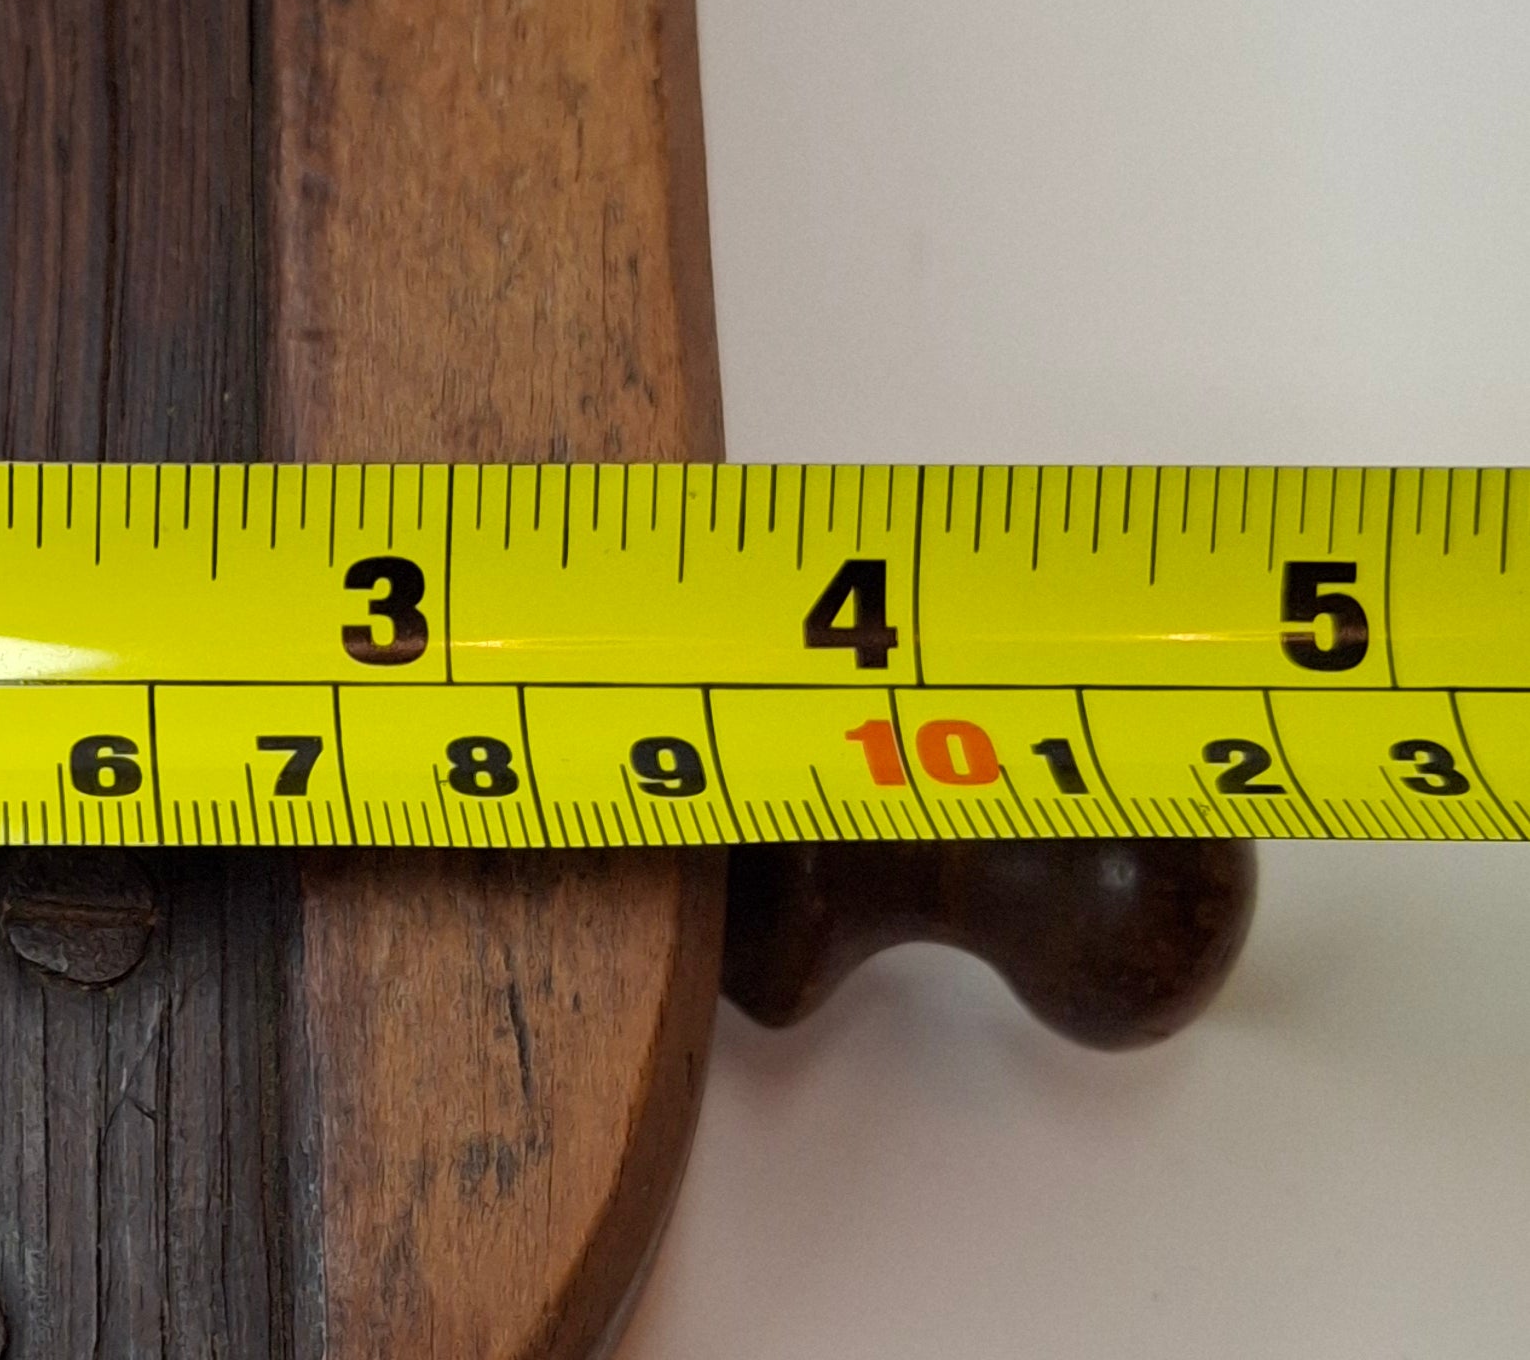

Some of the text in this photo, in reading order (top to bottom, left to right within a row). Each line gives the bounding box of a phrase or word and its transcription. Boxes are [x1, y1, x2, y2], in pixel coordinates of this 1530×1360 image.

[340, 555, 430, 666] 3
[802, 558, 899, 670] 4
[1279, 560, 1370, 673] 5
[69, 735, 143, 797] 6
[256, 735, 324, 796] 7
[445, 735, 520, 798] 8
[628, 736, 708, 798] 9
[845, 719, 1000, 787] 10
[1031, 737, 1089, 795] 1
[1201, 738, 1286, 795] 2
[1389, 738, 1471, 796] 3
